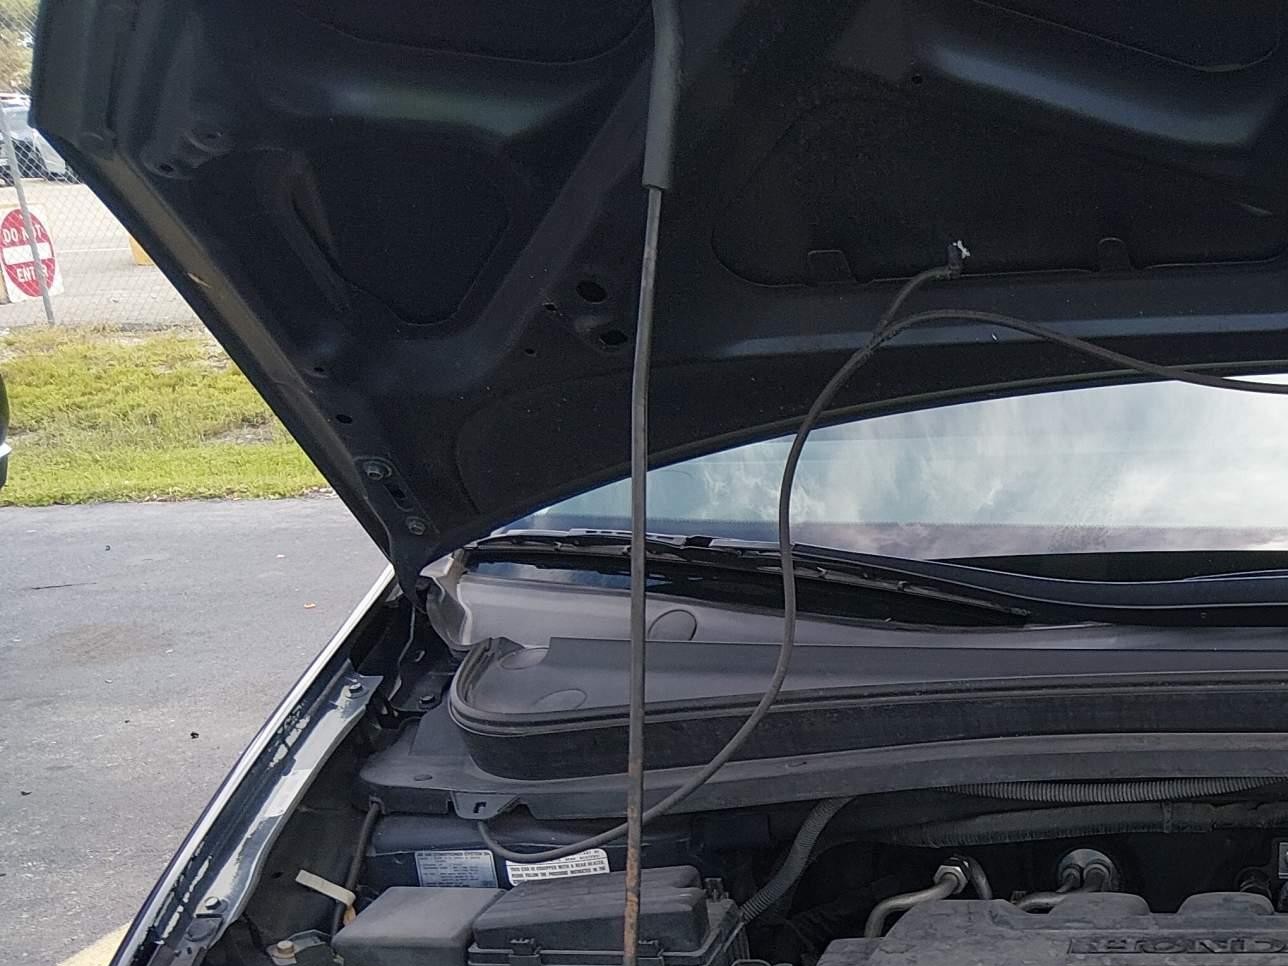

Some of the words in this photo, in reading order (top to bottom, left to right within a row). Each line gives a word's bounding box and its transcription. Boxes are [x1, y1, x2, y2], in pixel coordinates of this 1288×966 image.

[3, 228, 19, 243] DO
[22, 224, 43, 241] NT
[16, 265, 49, 283] ENTR
